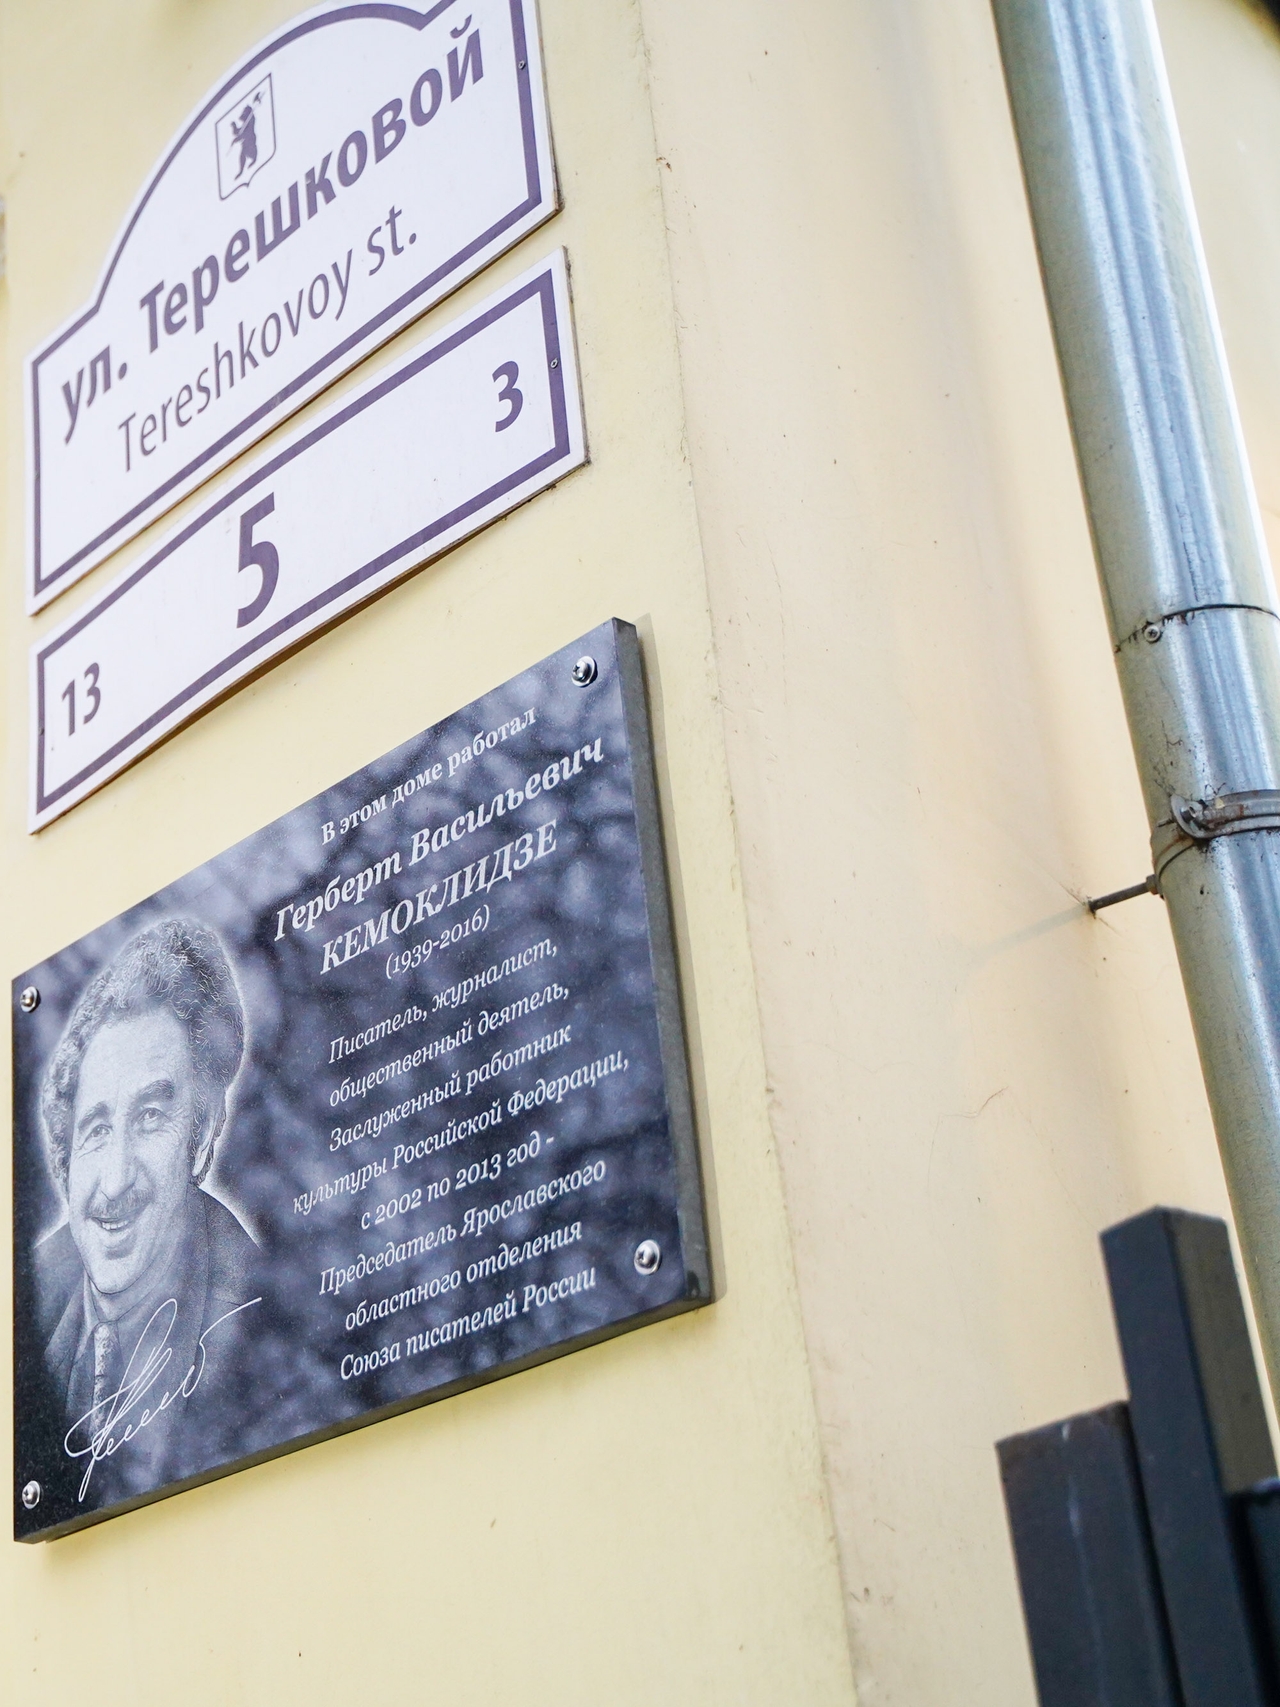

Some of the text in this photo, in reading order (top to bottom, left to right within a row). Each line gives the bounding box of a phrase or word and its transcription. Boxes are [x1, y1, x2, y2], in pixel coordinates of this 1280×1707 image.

[60, 15, 484, 443] ул. Терешковой
[119, 205, 417, 471] Tereshkovoy st.
[60, 361, 523, 736] 13 5 3
[274, 737, 604, 941] Герберт Васильевич
[322, 708, 536, 845] В этом доме работал
[320, 819, 558, 975] КЕМОКЛИДЗЕ
[385, 905, 490, 980] (1939-2016)
[328, 935, 558, 1064] Писатель, журналист,
[329, 980, 569, 1108] общественный деятель,
[293, 1049, 629, 1214] культуры Российской Федерации,
[329, 1023, 572, 1152] Заслуженный работник
[319, 1159, 607, 1295] Председатель Ярославского
[361, 1212, 370, 1230] с
[375, 1188, 422, 1225] 2002
[426, 1180, 450, 1204] по
[455, 1152, 501, 1191] 2013
[506, 1131, 541, 1169] год
[340, 1266, 597, 1380] Союза писателей России
[345, 1221, 582, 1330] областного отделения
